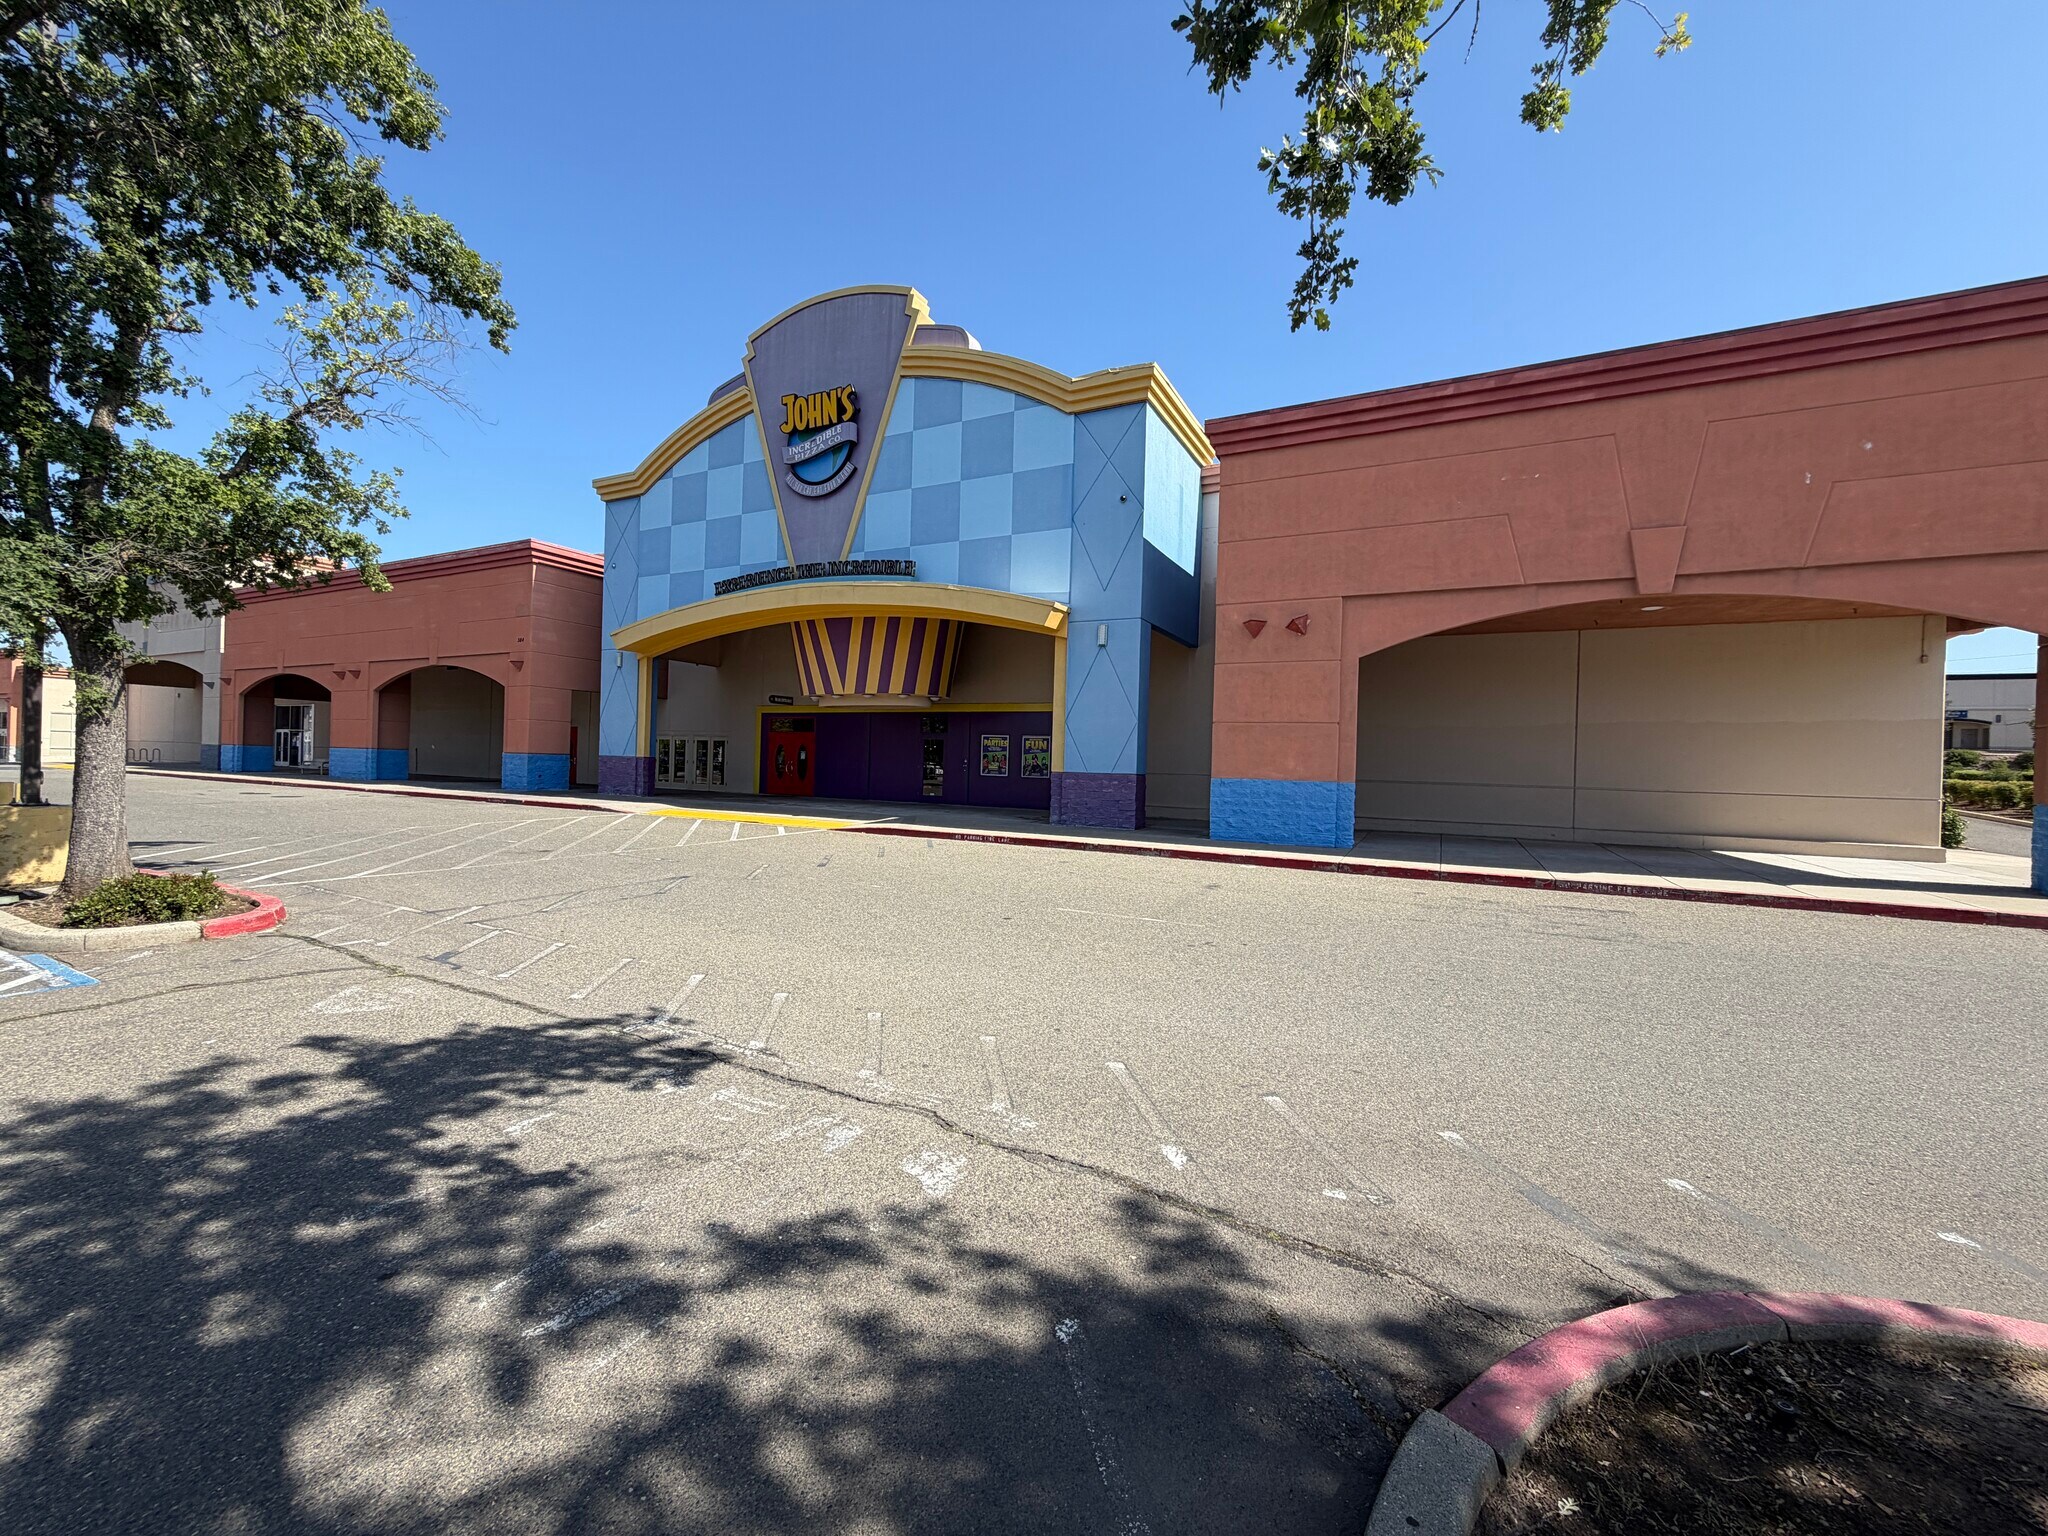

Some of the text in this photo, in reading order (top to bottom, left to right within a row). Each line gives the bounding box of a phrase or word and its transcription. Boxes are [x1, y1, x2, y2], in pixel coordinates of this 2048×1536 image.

[780, 384, 856, 434] JOHN'S
[788, 424, 843, 456] INCREDIBLE
[794, 435, 843, 462] PIZZA CO.
[713, 559, 917, 596] EXPERIENCE THE INCREDIBLE
[983, 739, 1008, 747] PARTIES
[1025, 740, 1047, 750] FUN
